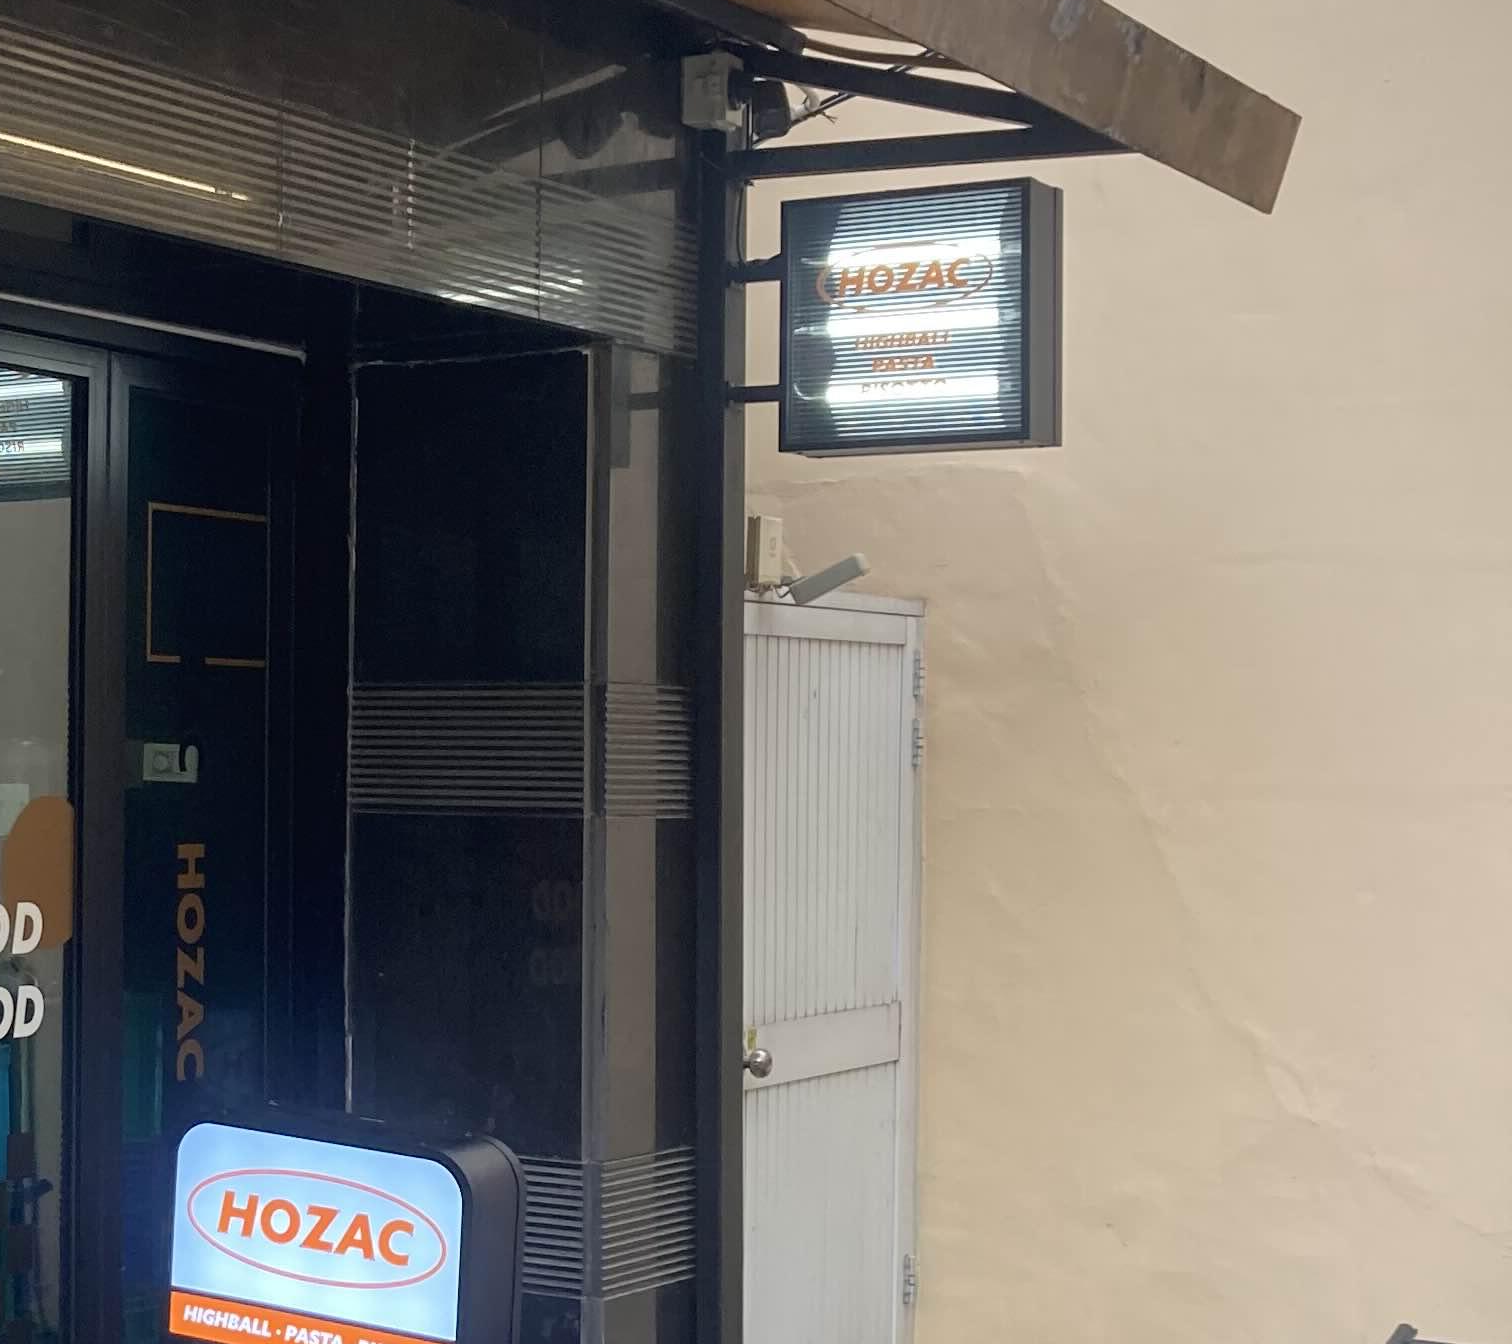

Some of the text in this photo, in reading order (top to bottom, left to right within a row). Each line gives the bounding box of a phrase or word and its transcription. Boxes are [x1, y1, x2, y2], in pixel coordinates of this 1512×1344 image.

[839, 258, 969, 297] HOZAC
[176, 843, 205, 1081] HOZAC
[217, 1190, 415, 1266] HOZAC
[183, 1304, 272, 1338] HIGHBALL
